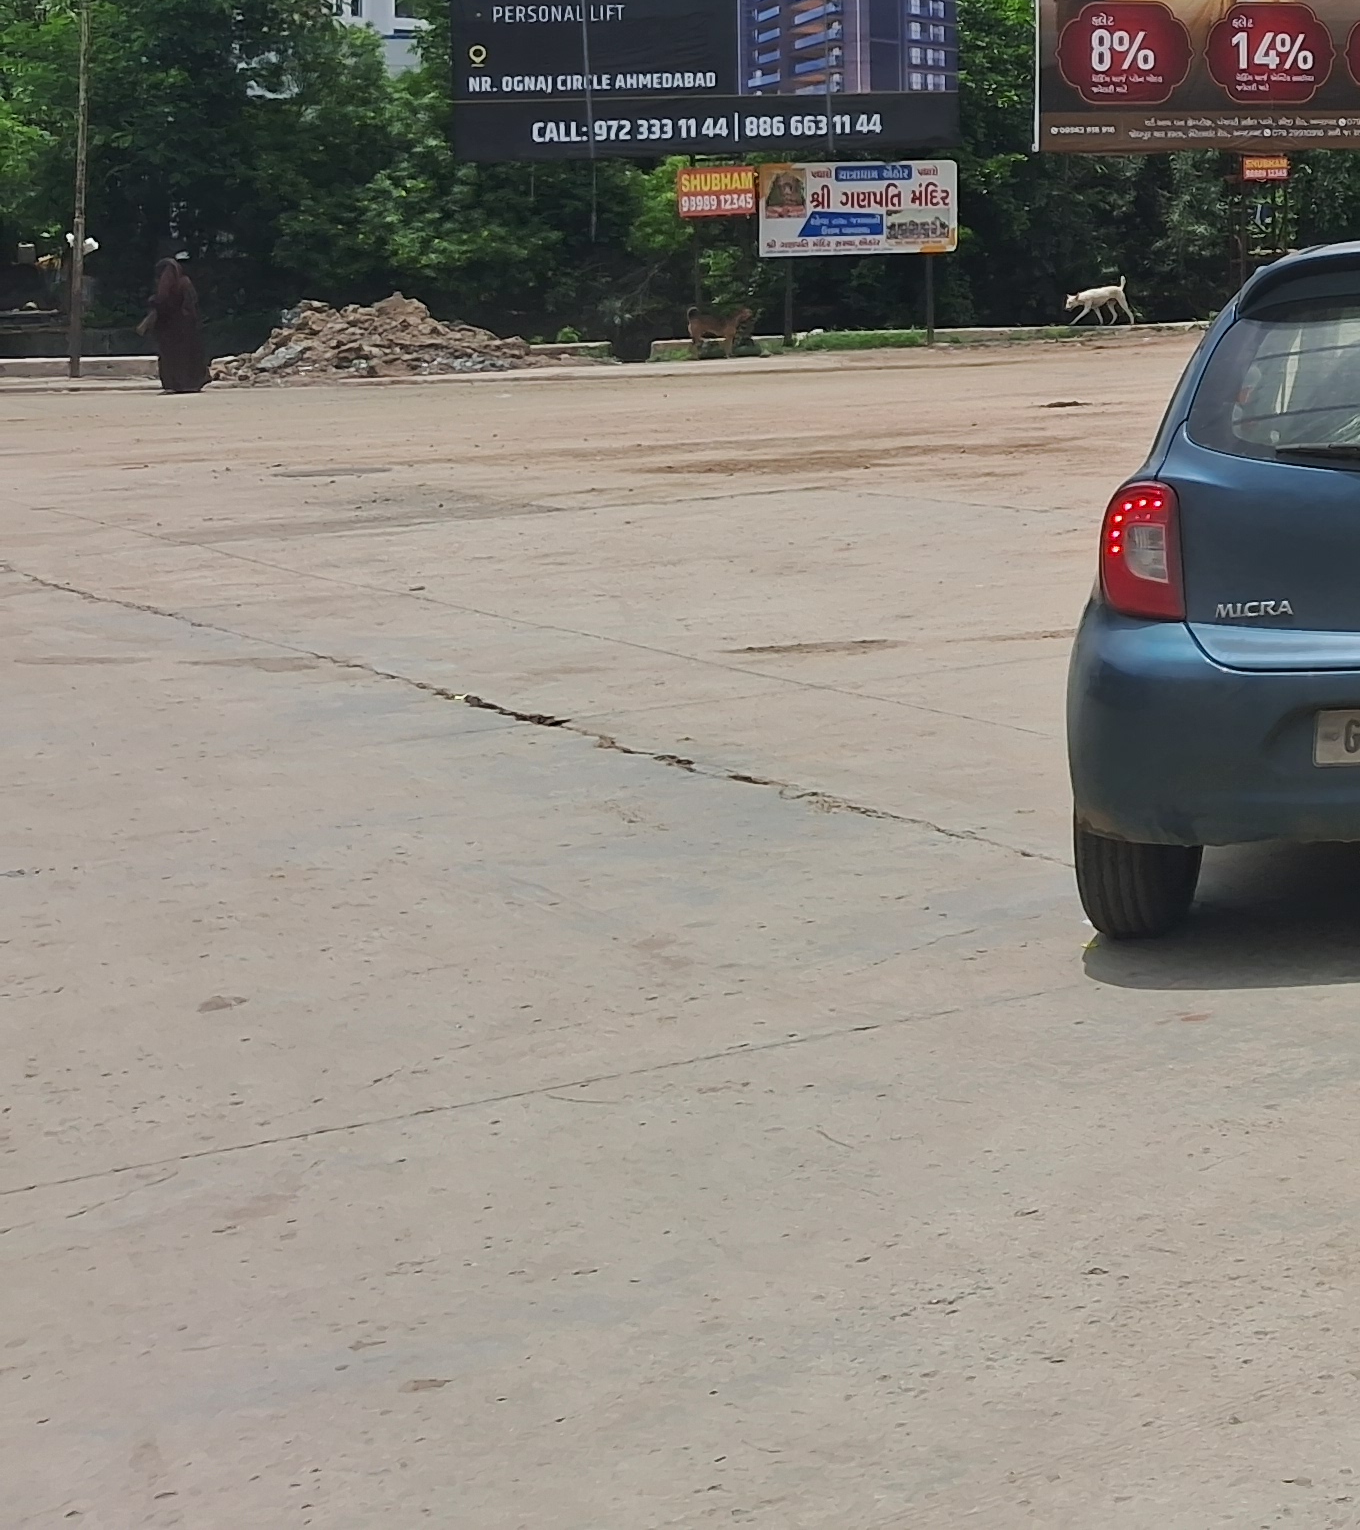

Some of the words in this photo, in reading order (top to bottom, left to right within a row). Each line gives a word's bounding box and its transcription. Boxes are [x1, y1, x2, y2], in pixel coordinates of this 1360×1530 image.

[492, 5, 584, 23] PERSONAL
[590, 4, 625, 21] LIFT
[1091, 28, 1155, 72] 8%
[1231, 31, 1314, 70] 14%
[468, 76, 498, 93] NR.
[501, 75, 552, 94] OGNAJ
[556, 74, 611, 91] CIRCLE
[615, 72, 716, 90] AHMEDABAD
[532, 121, 589, 142] CALL:
[594, 120, 632, 141] 972
[636, 119, 673, 140] 333
[677, 118, 697, 139] 11
[701, 117, 728, 138] 44
[745, 116, 784, 137] 886
[790, 115, 827, 136] 663
[832, 115, 851, 134] 11
[855, 113, 882, 134] 44
[682, 171, 753, 191] SHUBHAM
[720, 193, 753, 210] 12345
[810, 184, 831, 209] શ્રી
[840, 182, 902, 209] ગણપતિ
[911, 181, 950, 207] મંદિર
[1215, 600, 1294, 619] MICRA
